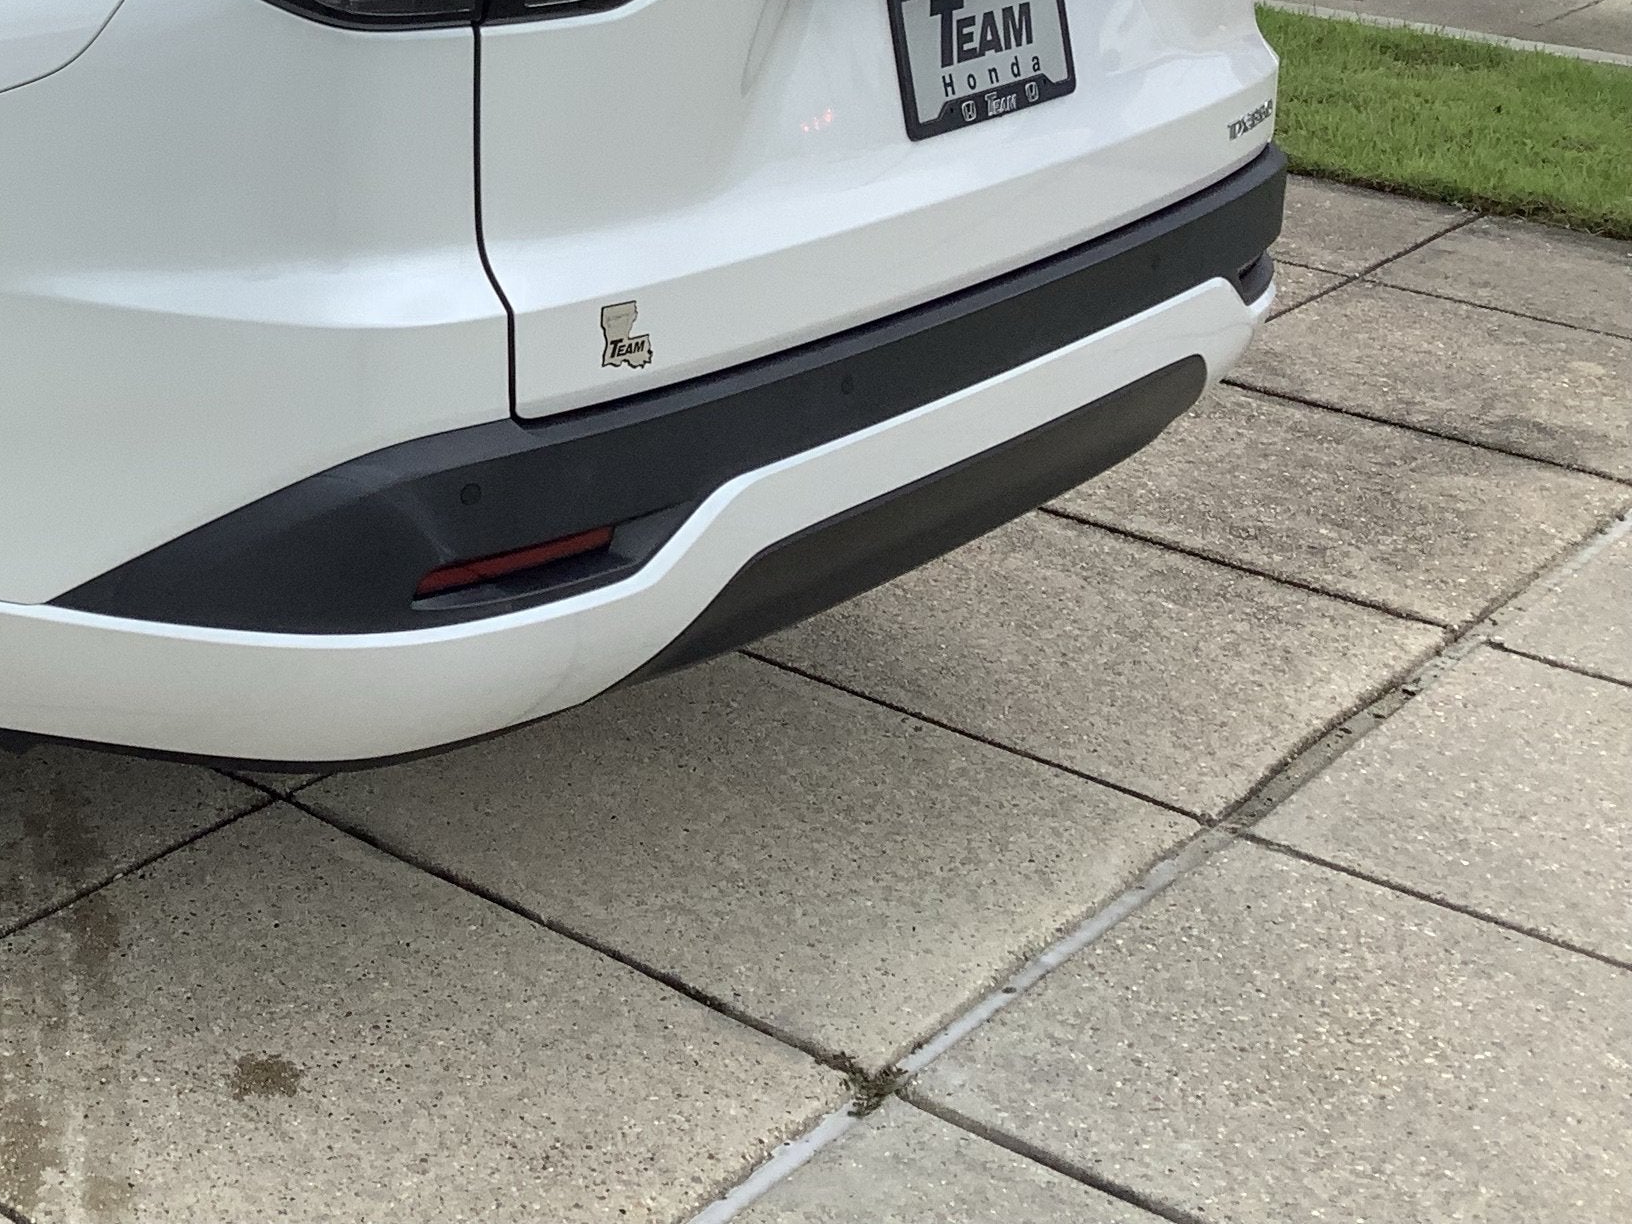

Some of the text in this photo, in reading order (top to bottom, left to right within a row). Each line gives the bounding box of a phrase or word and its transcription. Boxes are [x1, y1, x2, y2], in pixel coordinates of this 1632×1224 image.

[941, 55, 1041, 98] Honda
[984, 91, 1017, 117] TEAM
[609, 337, 646, 359] TEAM
